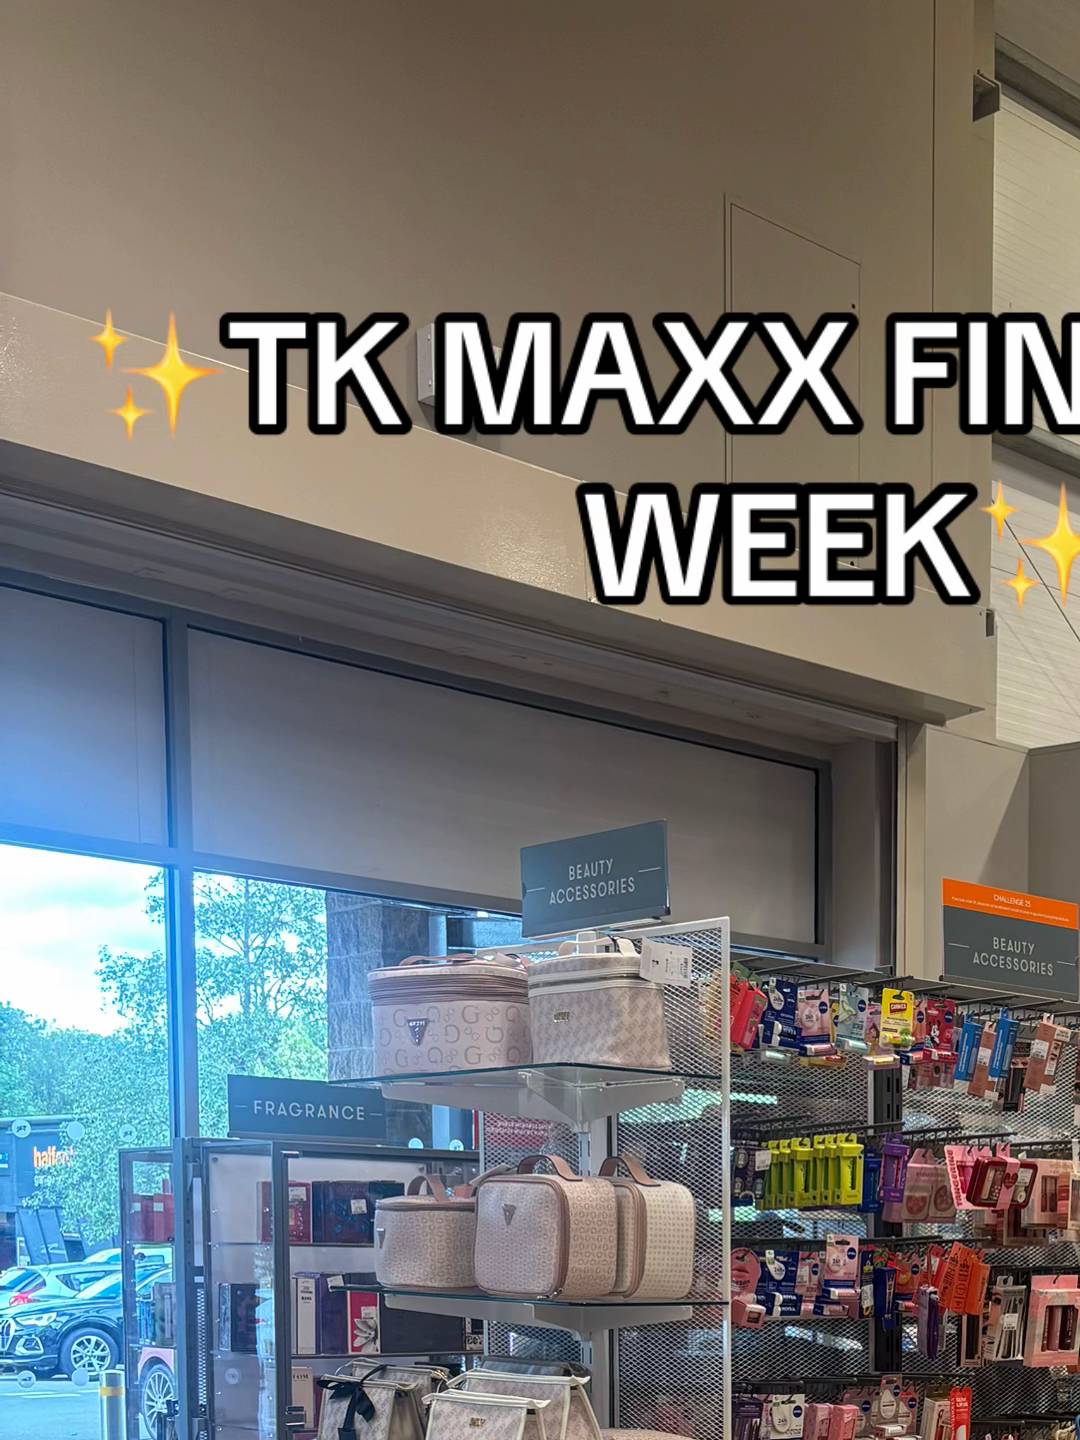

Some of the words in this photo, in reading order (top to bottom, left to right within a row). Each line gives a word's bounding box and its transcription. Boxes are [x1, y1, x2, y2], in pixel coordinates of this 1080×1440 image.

[568, 858, 614, 881] BEAUTY
[549, 876, 635, 905] ACCESSORIES
[993, 937, 1035, 955] BEAUTY
[973, 952, 1054, 976] ACCESSORIES
[253, 1099, 366, 1121] FRAGRANCE
